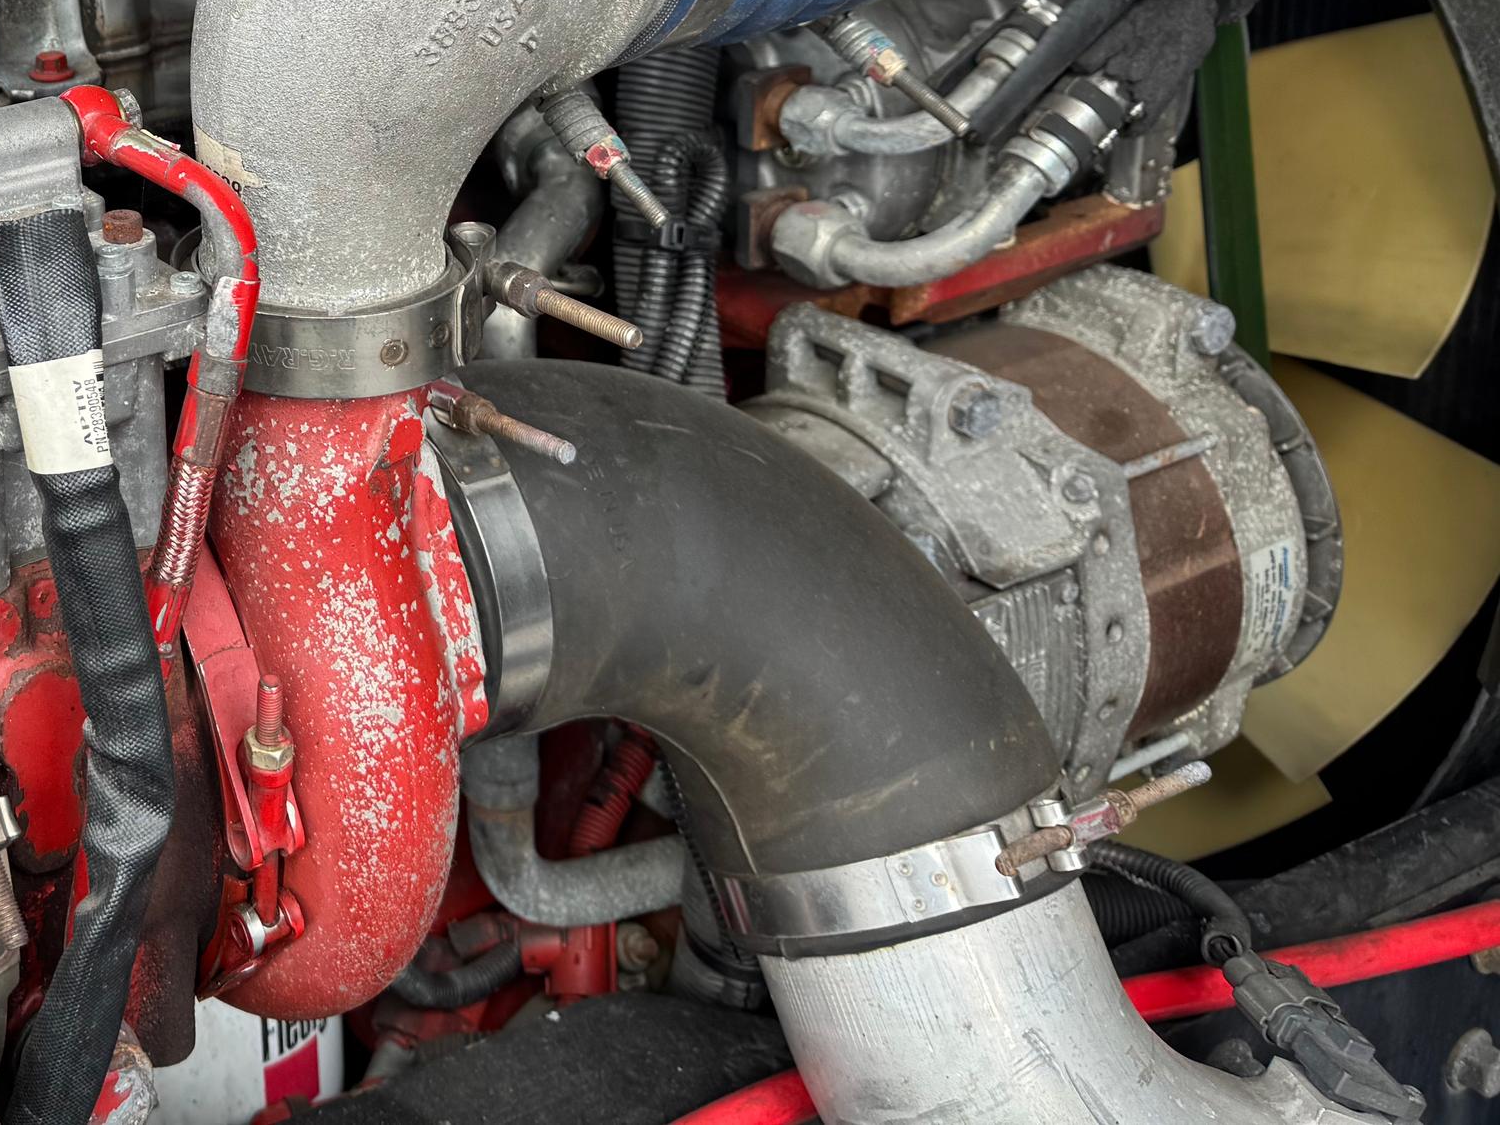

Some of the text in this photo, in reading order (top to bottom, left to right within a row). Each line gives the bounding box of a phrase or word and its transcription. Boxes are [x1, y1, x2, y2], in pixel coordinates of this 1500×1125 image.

[250, 342, 356, 371] R.G.RAY
[72, 380, 94, 445] APTIV
[84, 378, 109, 453] PN:28390548
